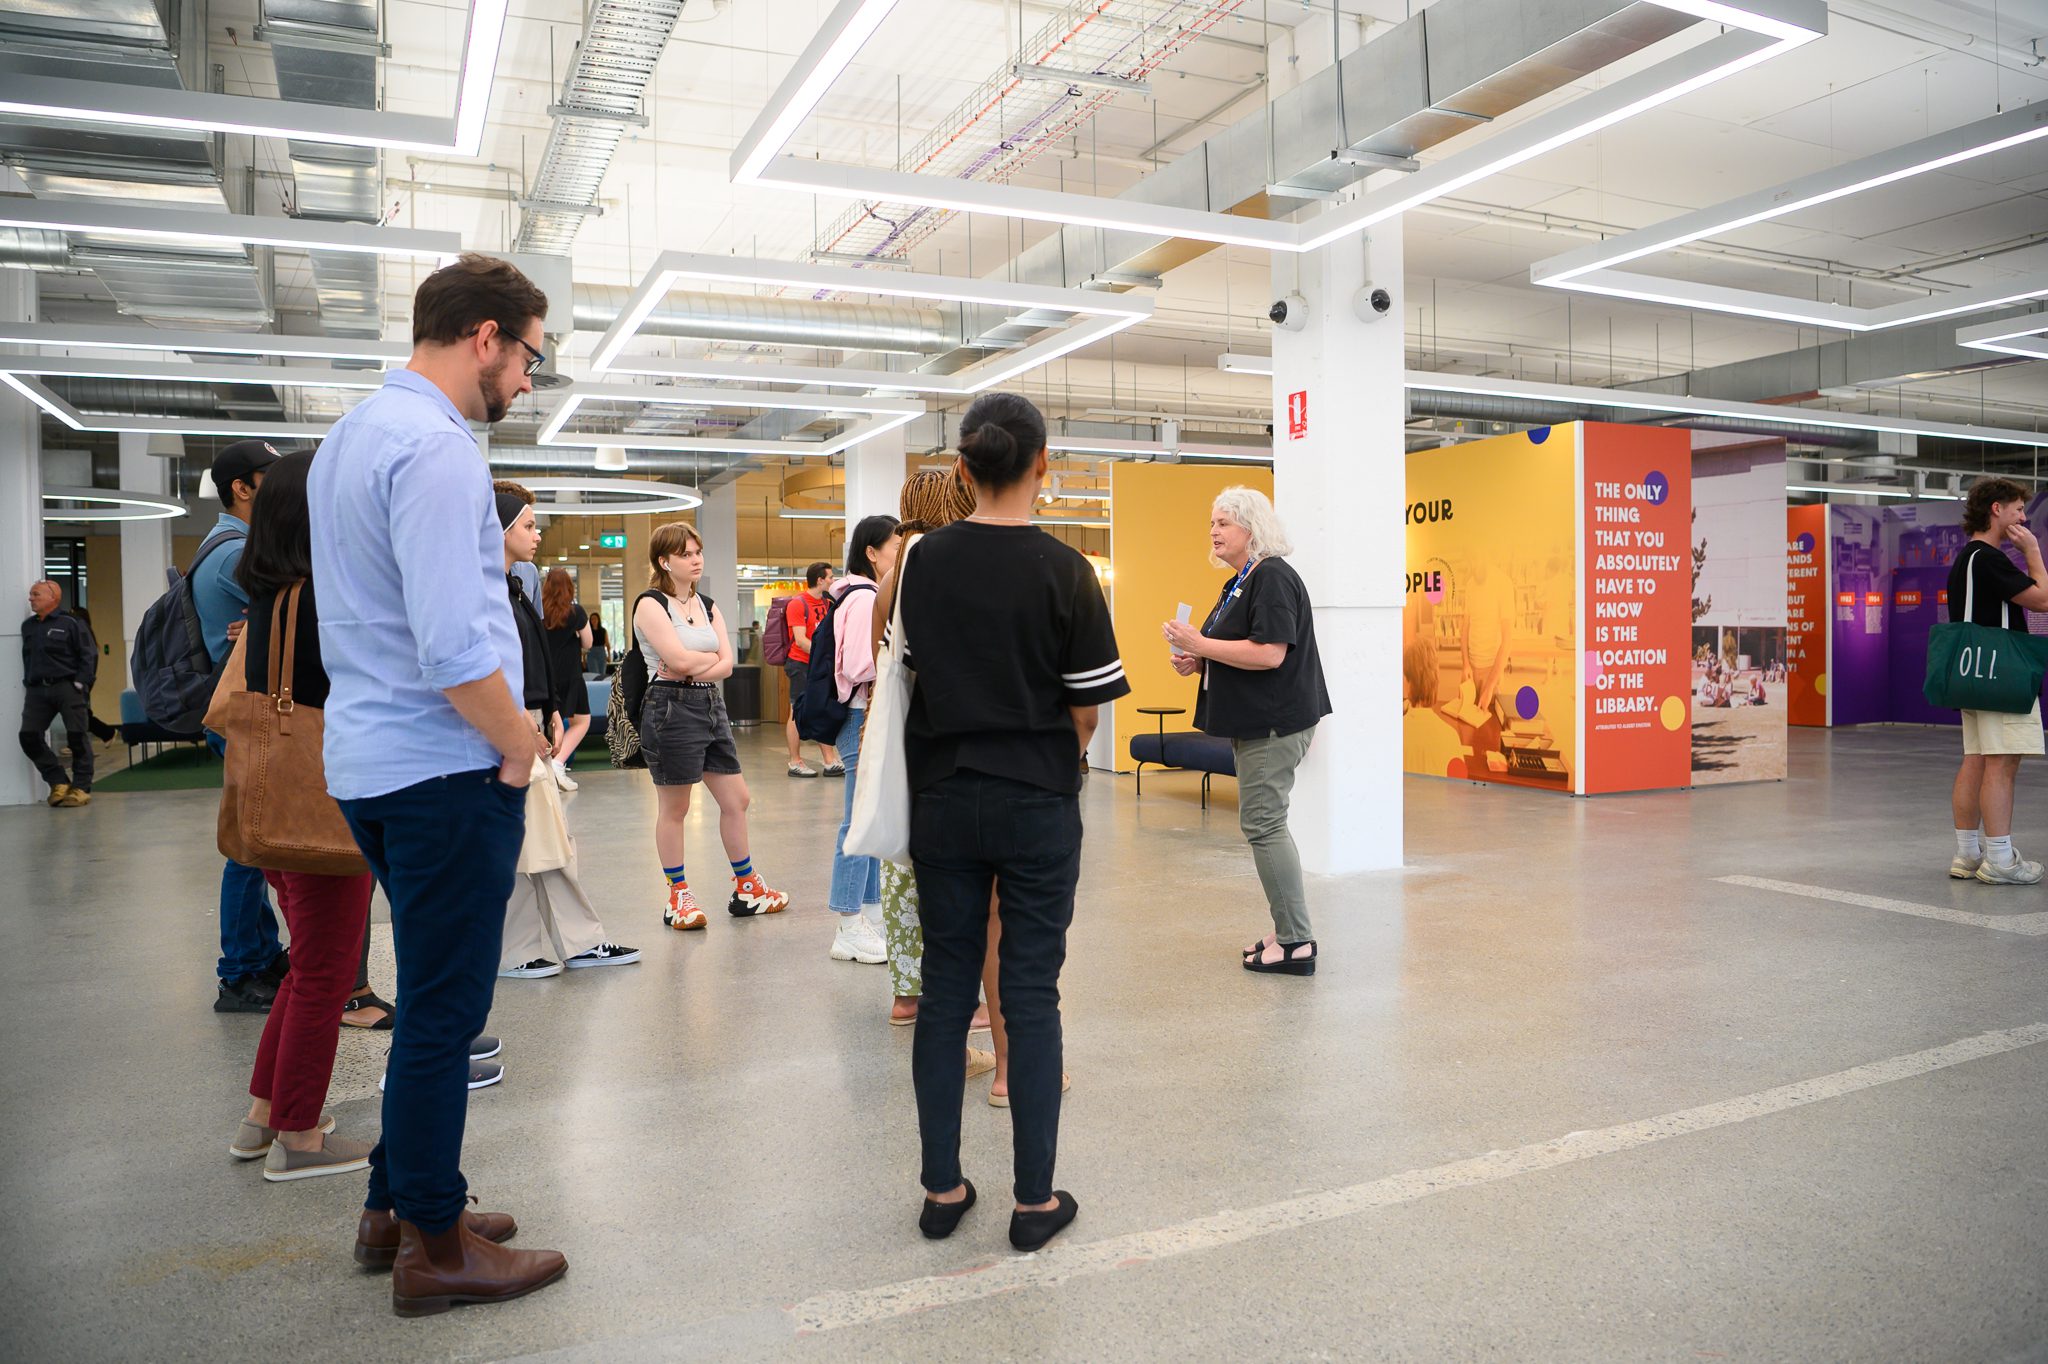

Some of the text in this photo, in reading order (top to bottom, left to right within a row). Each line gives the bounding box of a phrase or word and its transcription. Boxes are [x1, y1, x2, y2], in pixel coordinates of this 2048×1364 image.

[1595, 482, 1662, 501] THE ONLY
[1595, 506, 1640, 523] THING
[1595, 530, 1664, 548] THAT YOU
[1595, 554, 1681, 571] ABSOLUTELY
[1787, 554, 1812, 564] ANDS
[1787, 568, 1818, 578] ERENT
[1595, 578, 1656, 595] HAVE TO
[1595, 601, 1643, 618] KNOW
[1596, 625, 1638, 642] IS THE
[1801, 622, 1815, 632] OF
[1596, 648, 1667, 666] LOCATION
[1595, 672, 1644, 690] OF THE
[1596, 695, 1658, 714] LIBRARY.
